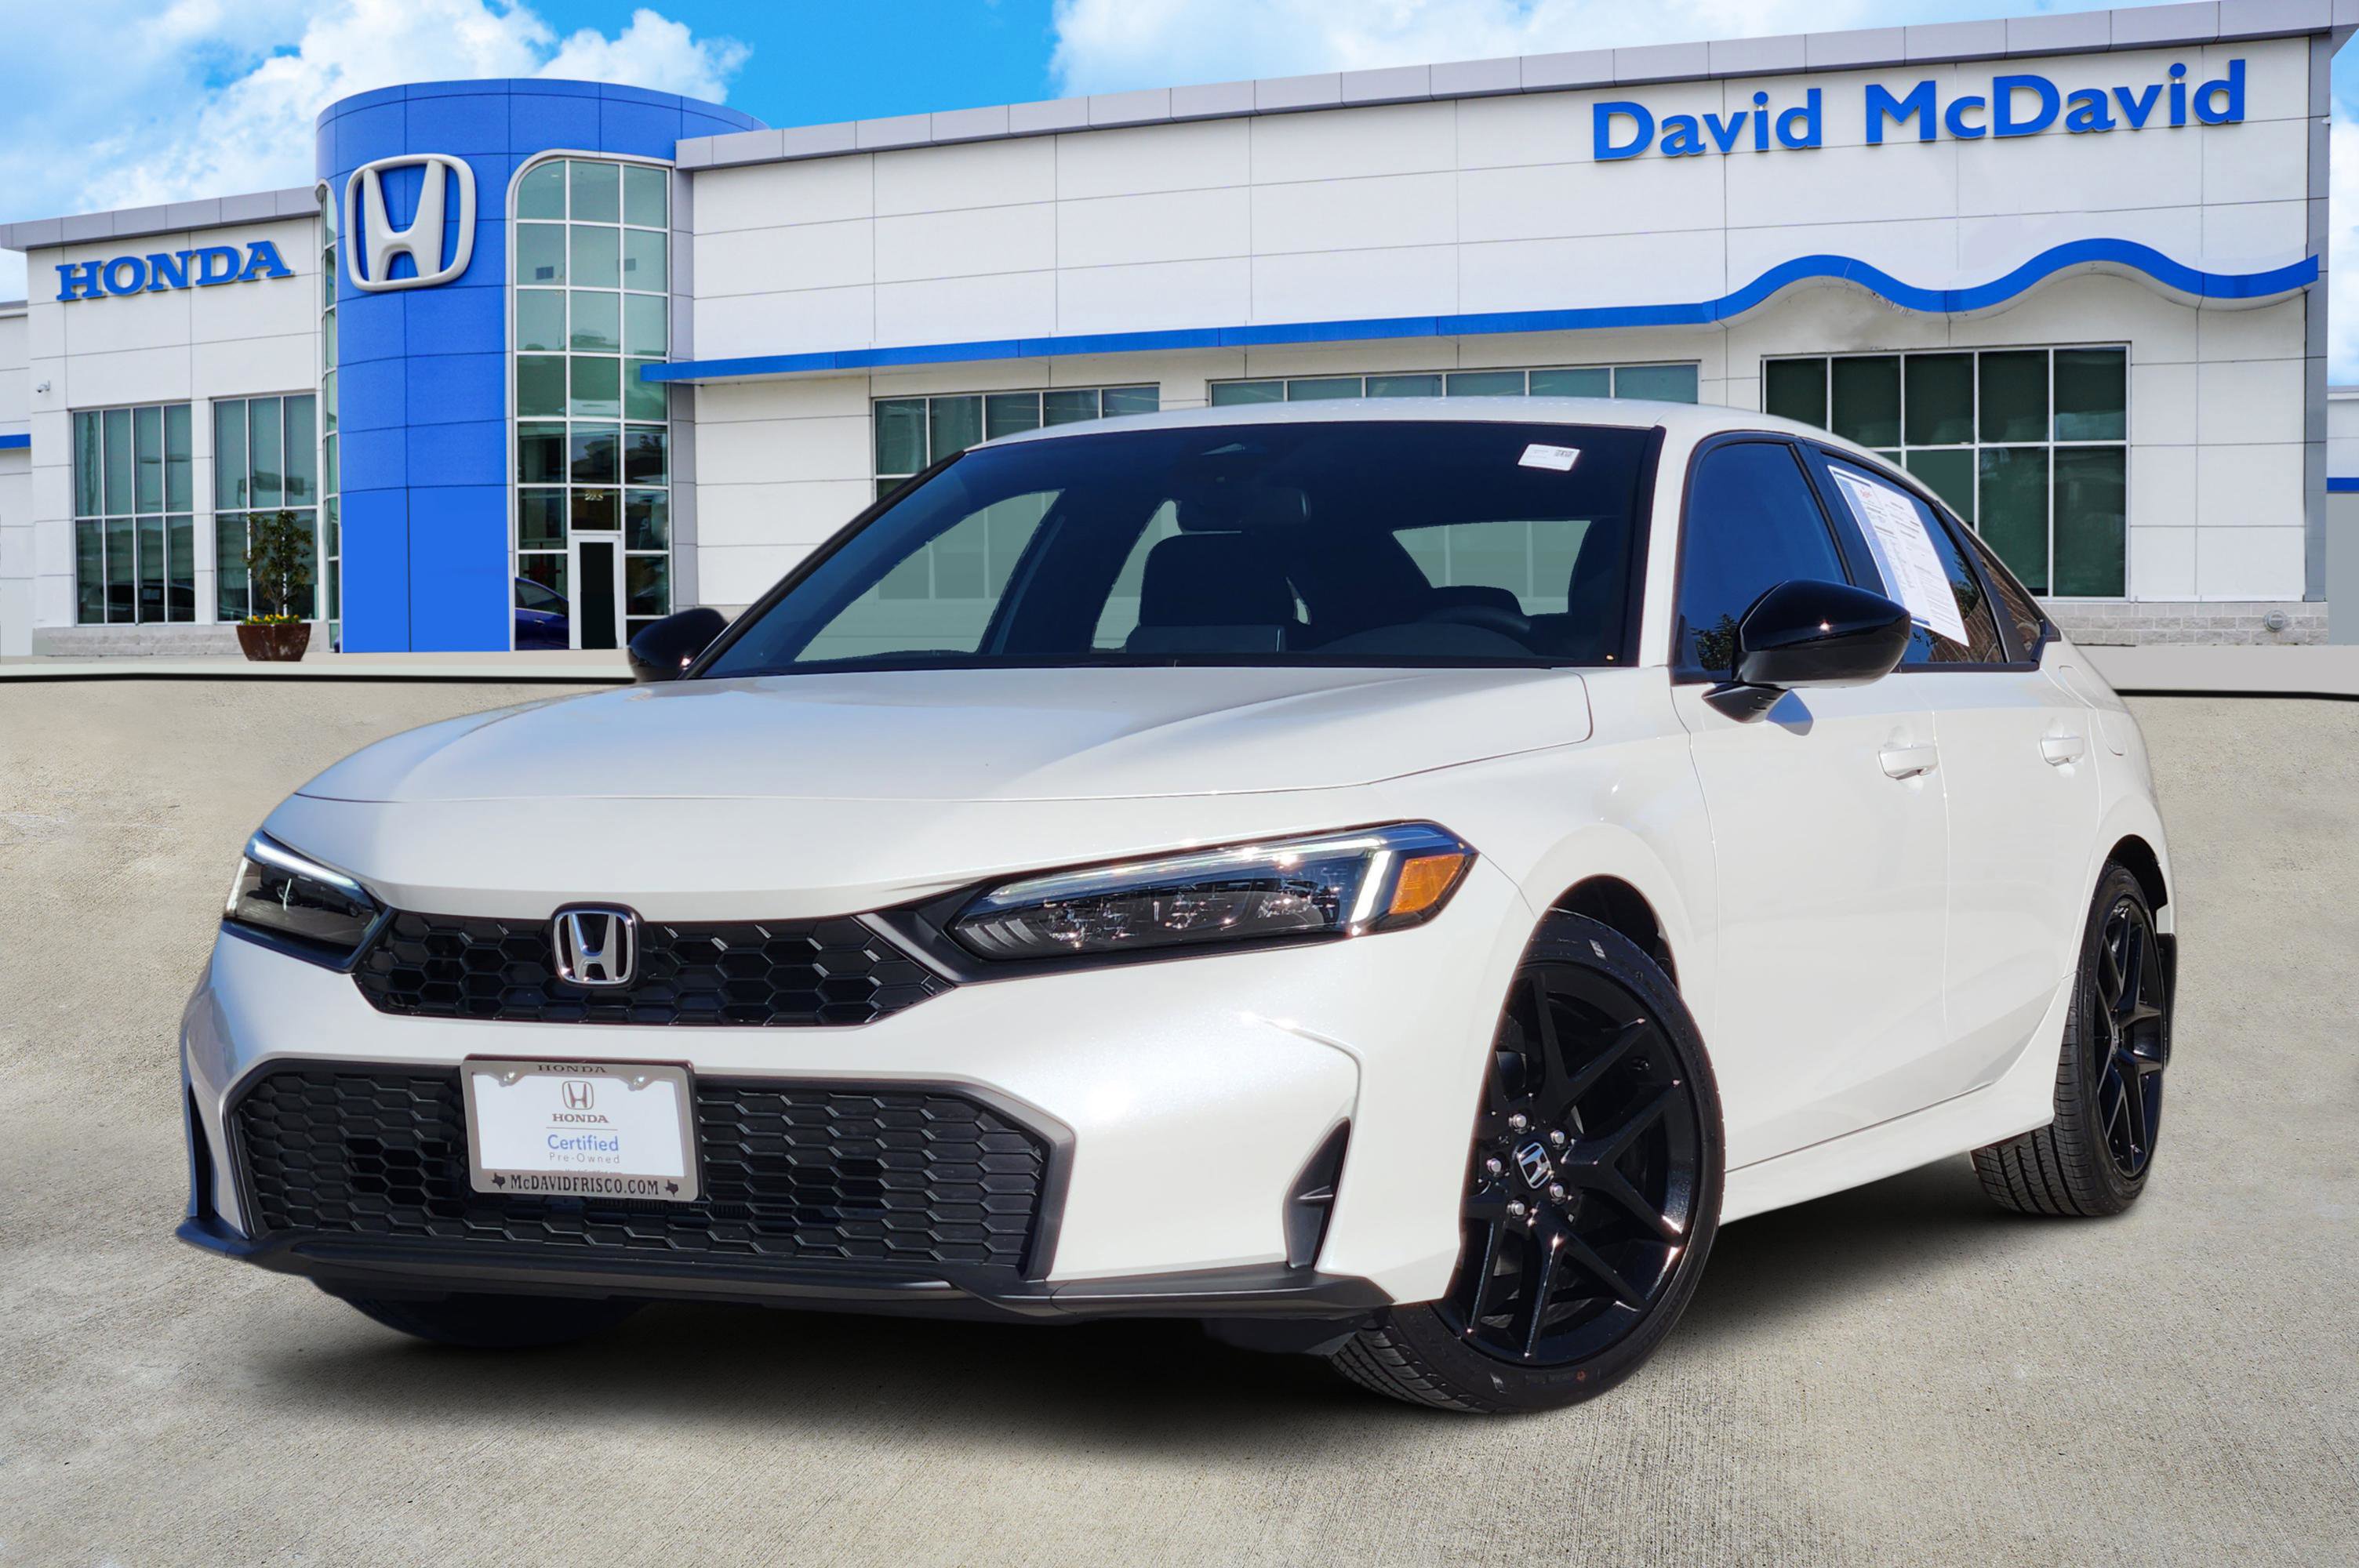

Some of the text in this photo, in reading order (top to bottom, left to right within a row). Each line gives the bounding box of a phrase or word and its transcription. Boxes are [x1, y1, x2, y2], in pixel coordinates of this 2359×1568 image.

[1593, 59, 2247, 162] David McDavid
[56, 240, 292, 302] HONDA
[552, 1113, 609, 1123] HONDA
[547, 1134, 619, 1152] Certified
[549, 1152, 620, 1164] Pre-Owned
